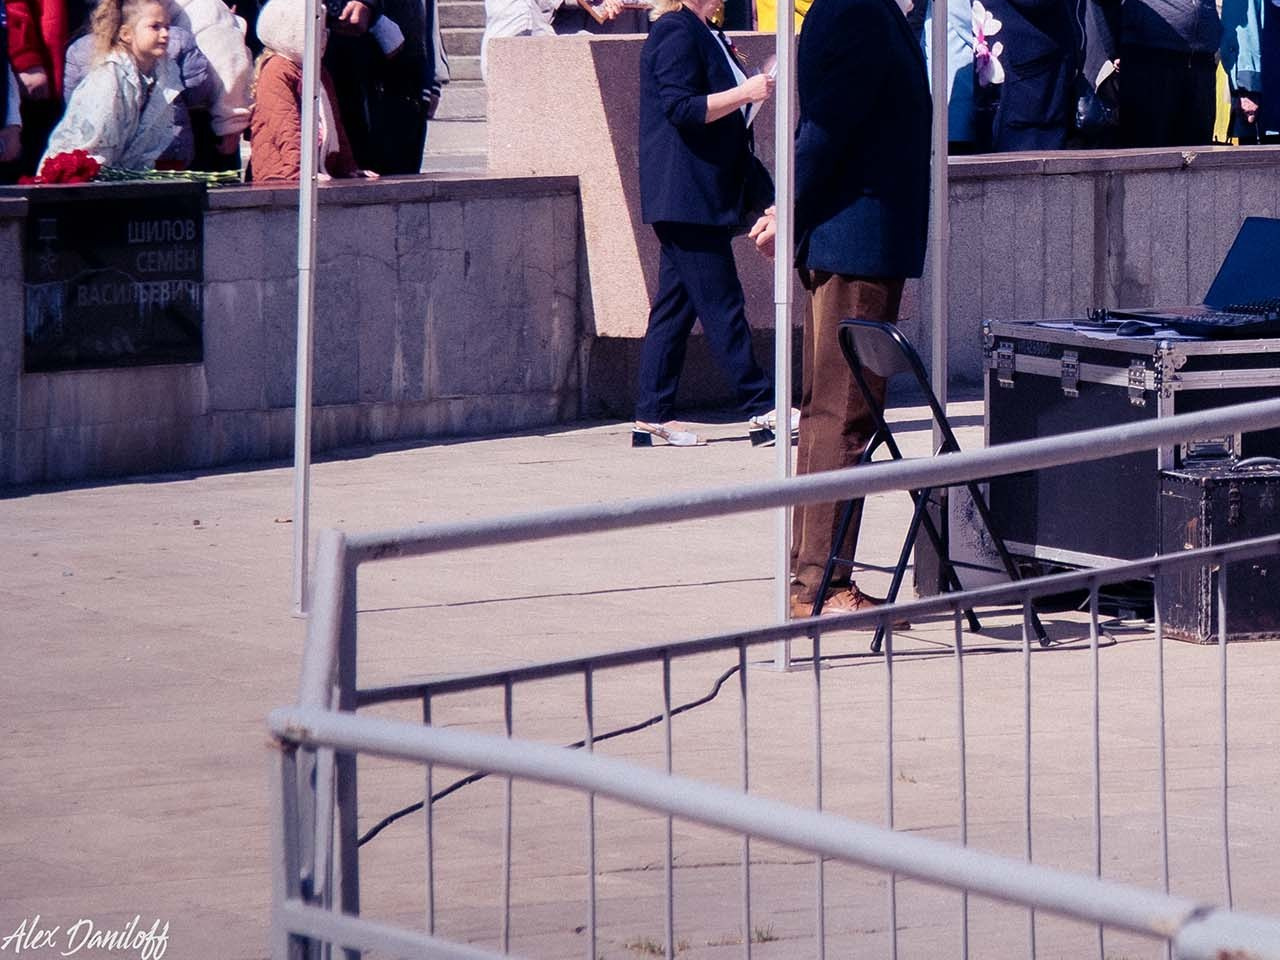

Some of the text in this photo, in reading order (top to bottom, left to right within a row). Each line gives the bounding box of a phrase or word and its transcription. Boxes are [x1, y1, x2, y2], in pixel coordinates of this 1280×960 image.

[128, 220, 196, 243] ШИЛОВ
[136, 244, 197, 272] СЕМЁН
[77, 282, 201, 307] ВАСИЛЬЕВИЧ
